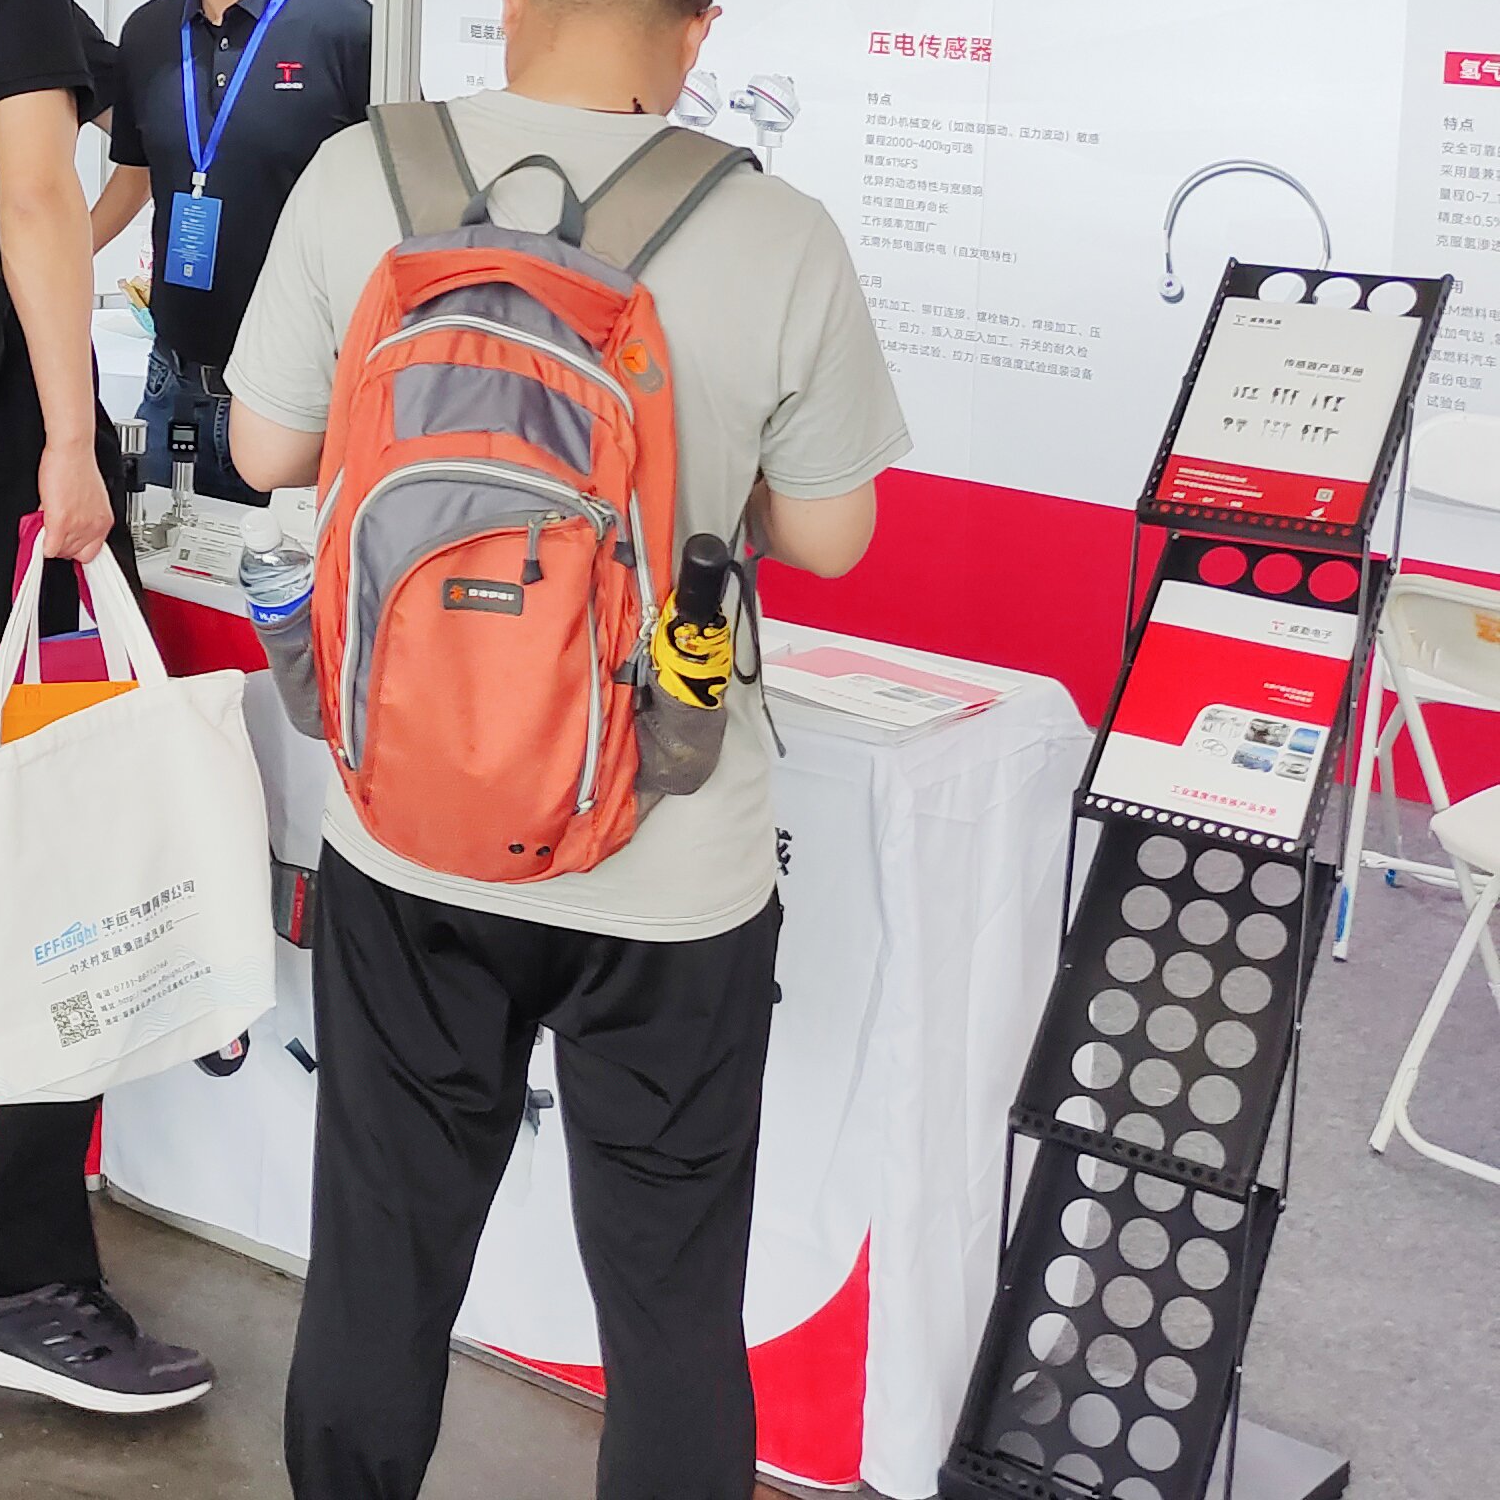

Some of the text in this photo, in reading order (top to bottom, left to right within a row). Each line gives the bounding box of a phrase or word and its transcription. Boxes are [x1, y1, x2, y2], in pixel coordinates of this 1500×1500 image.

[867, 31, 993, 63] 压电传感器
[866, 91, 892, 106] 特点
[1443, 116, 1474, 132] 特点
[858, 274, 883, 290] 应用
[1284, 358, 1364, 377] 传感器产品手册
[1428, 371, 1482, 390] 备份电源
[1426, 395, 1466, 412] 试验台
